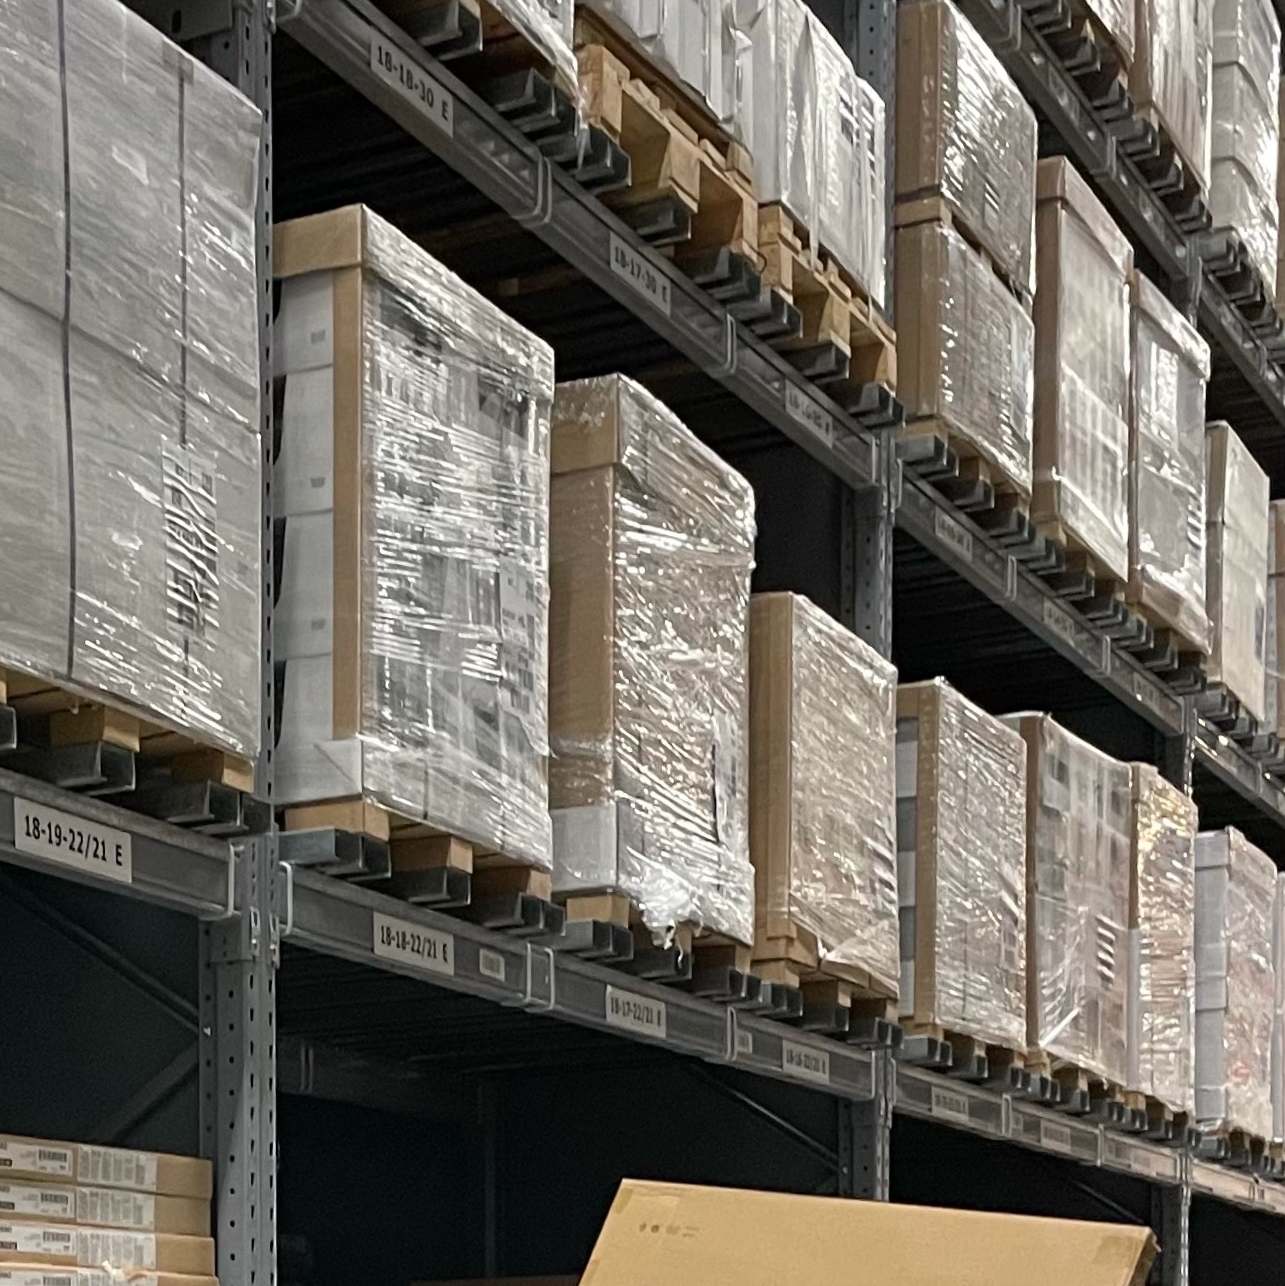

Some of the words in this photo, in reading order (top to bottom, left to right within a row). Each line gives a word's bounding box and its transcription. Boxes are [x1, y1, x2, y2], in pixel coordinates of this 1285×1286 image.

[442, 100, 448, 121] E
[24, 815, 107, 862] 18-19-22/21
[115, 844, 123, 866] E
[380, 925, 437, 960] 18-18-22/21
